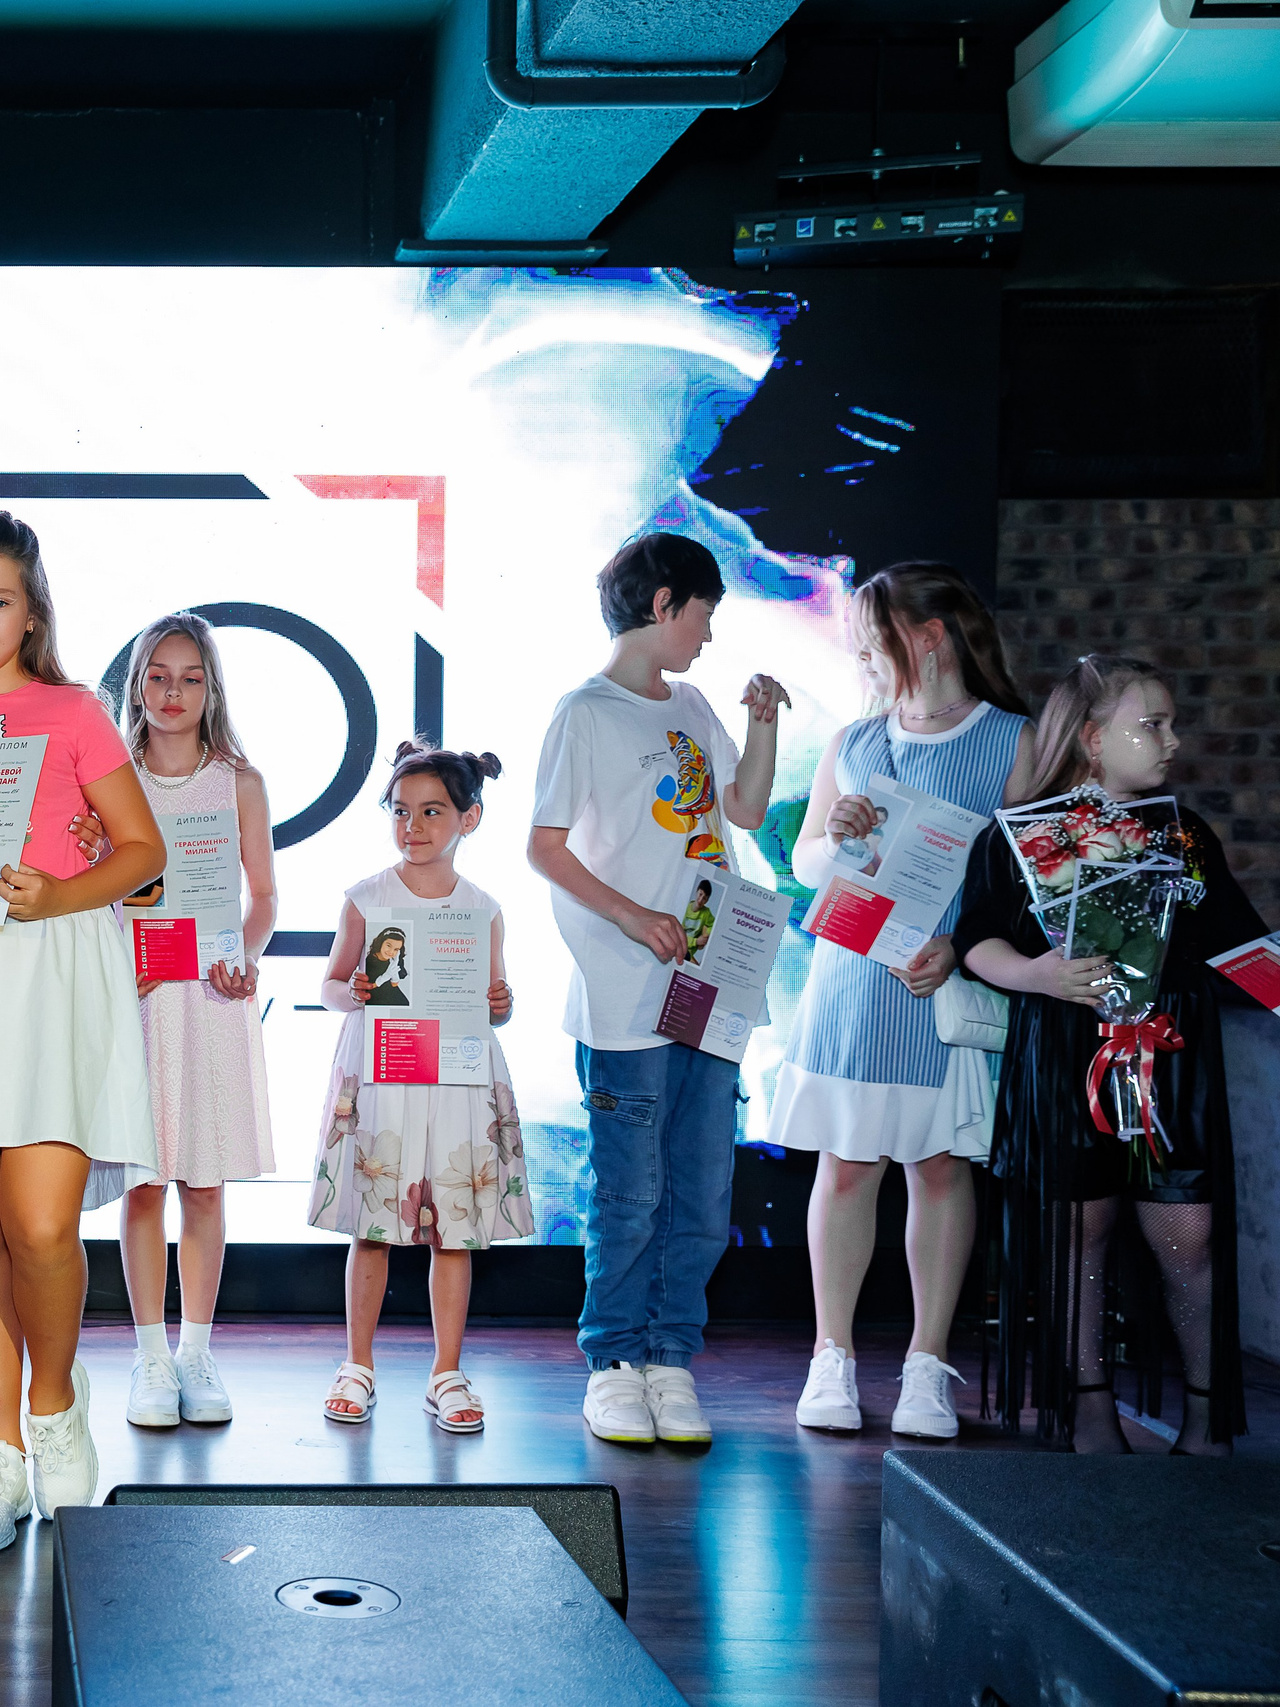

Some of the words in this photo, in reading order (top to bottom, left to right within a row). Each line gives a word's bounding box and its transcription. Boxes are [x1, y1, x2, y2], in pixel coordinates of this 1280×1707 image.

[930, 802, 973, 824] ДИПЛОМ
[176, 815, 218, 826] ДИПЛОМ
[174, 838, 229, 848] ГЕРАСИМЕНКО
[185, 847, 218, 856] МИЛАНЕ
[740, 884, 776, 902] ДИПЛОМ
[428, 912, 472, 921] ДИПЛОМ
[736, 918, 763, 933] БОРИСУ
[430, 937, 476, 946] БРЕЖНЕВОЙ
[436, 946, 470, 954] МИЛАНЕ
